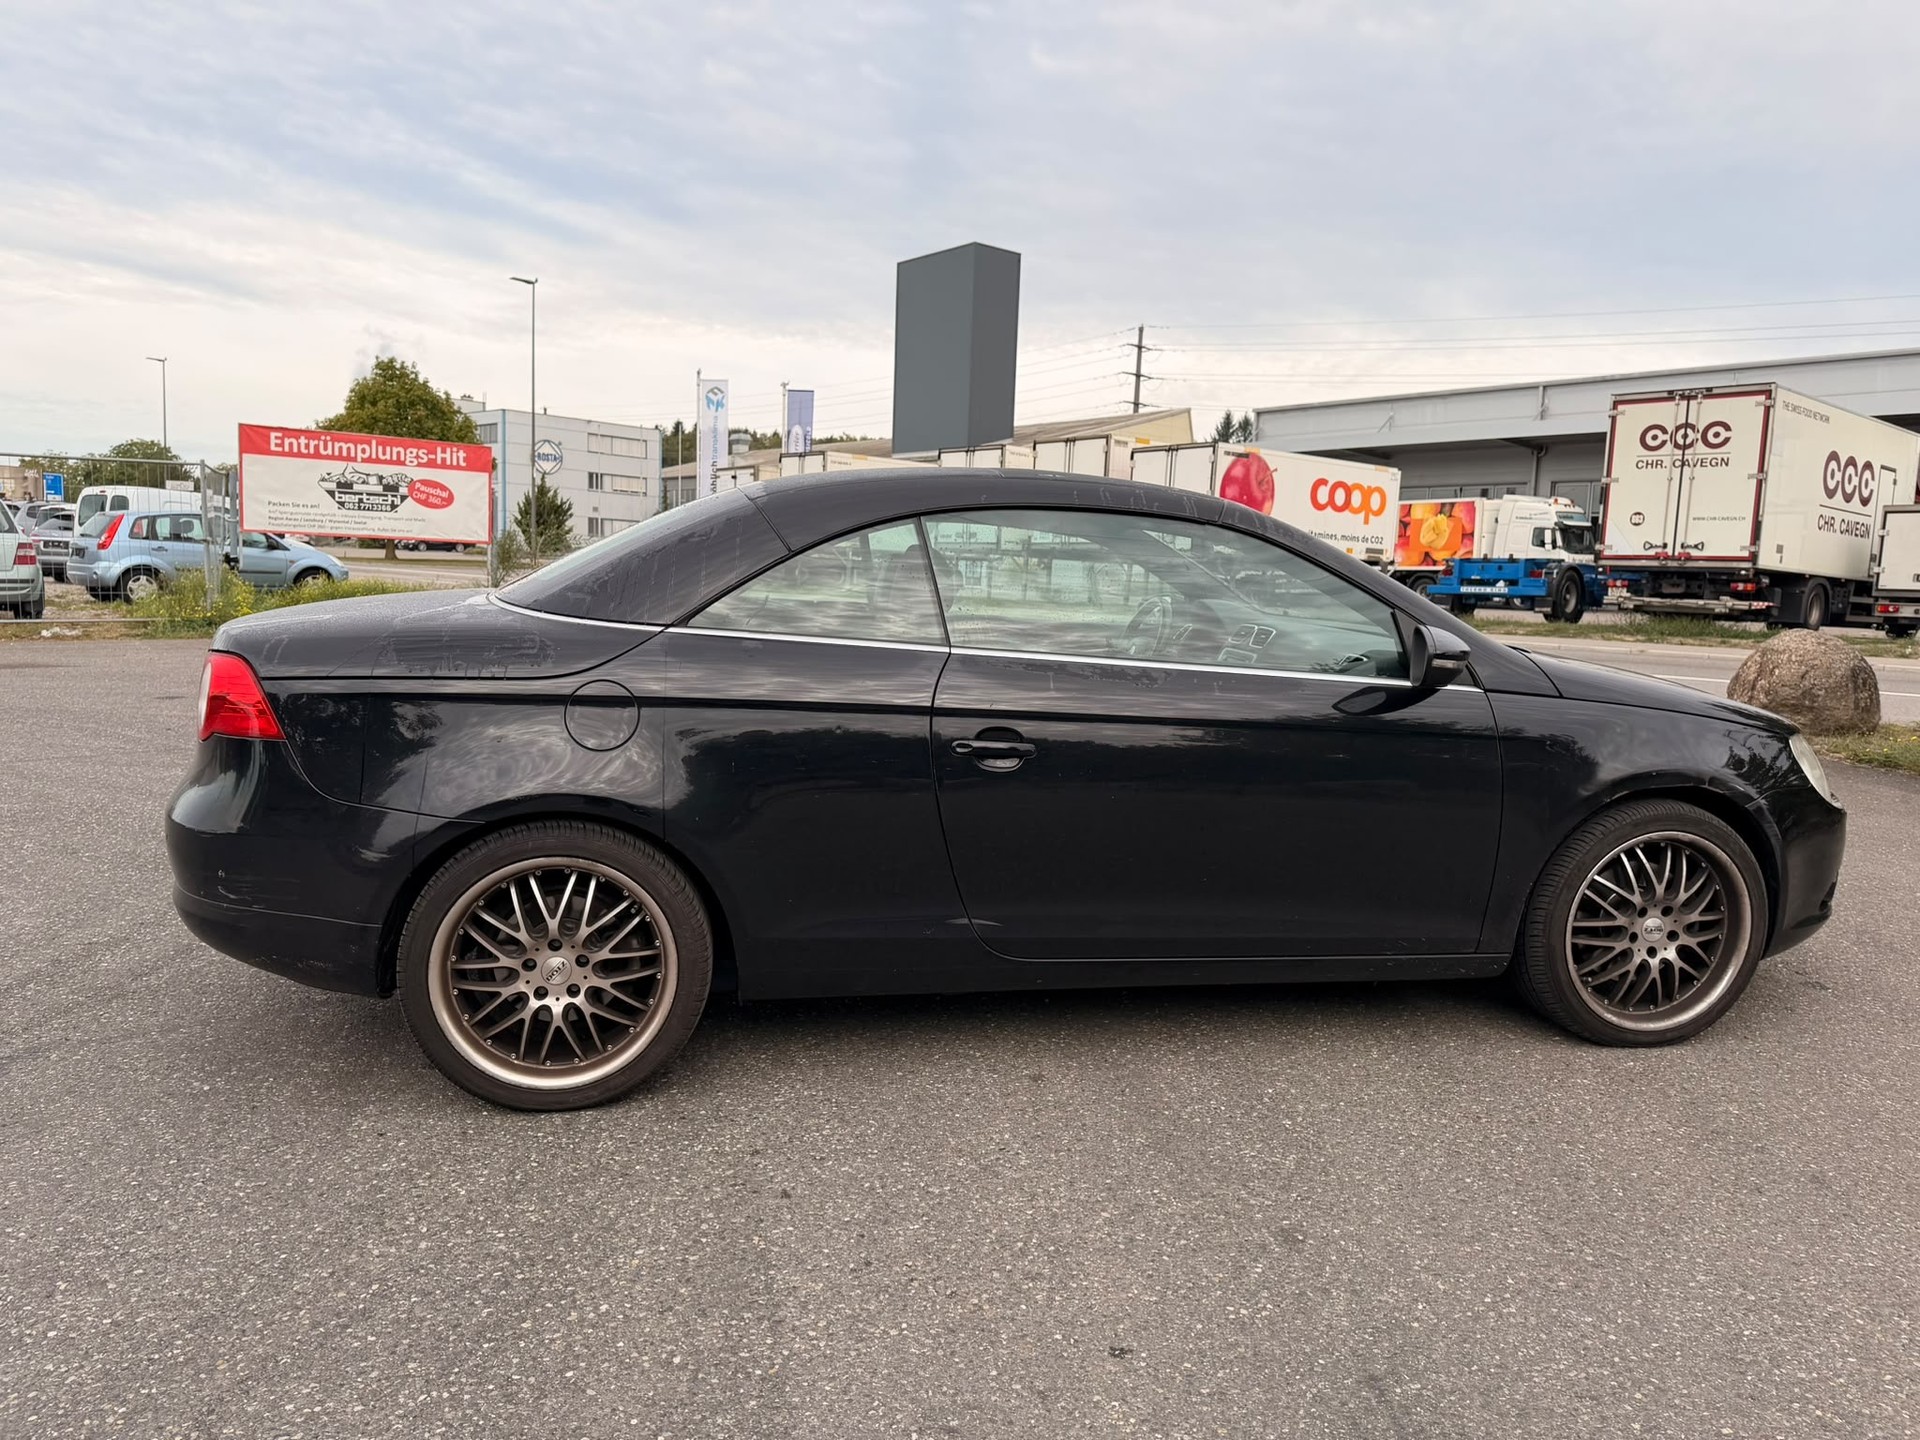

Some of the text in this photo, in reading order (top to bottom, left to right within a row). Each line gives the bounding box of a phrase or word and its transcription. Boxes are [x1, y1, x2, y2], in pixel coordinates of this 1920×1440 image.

[269, 432, 467, 466] Entrümplungs-Hit
[1635, 457, 1730, 470] CHR. CAVEGN
[413, 491, 428, 501] CHF
[415, 482, 450, 499] Pauschal
[344, 502, 359, 510] 062
[1310, 477, 1387, 525] coop
[1817, 514, 1871, 539] CHR. CAVEGN
[1340, 534, 1360, 543] moins
[1362, 532, 1369, 544] de
[1370, 534, 1384, 545] CO2
